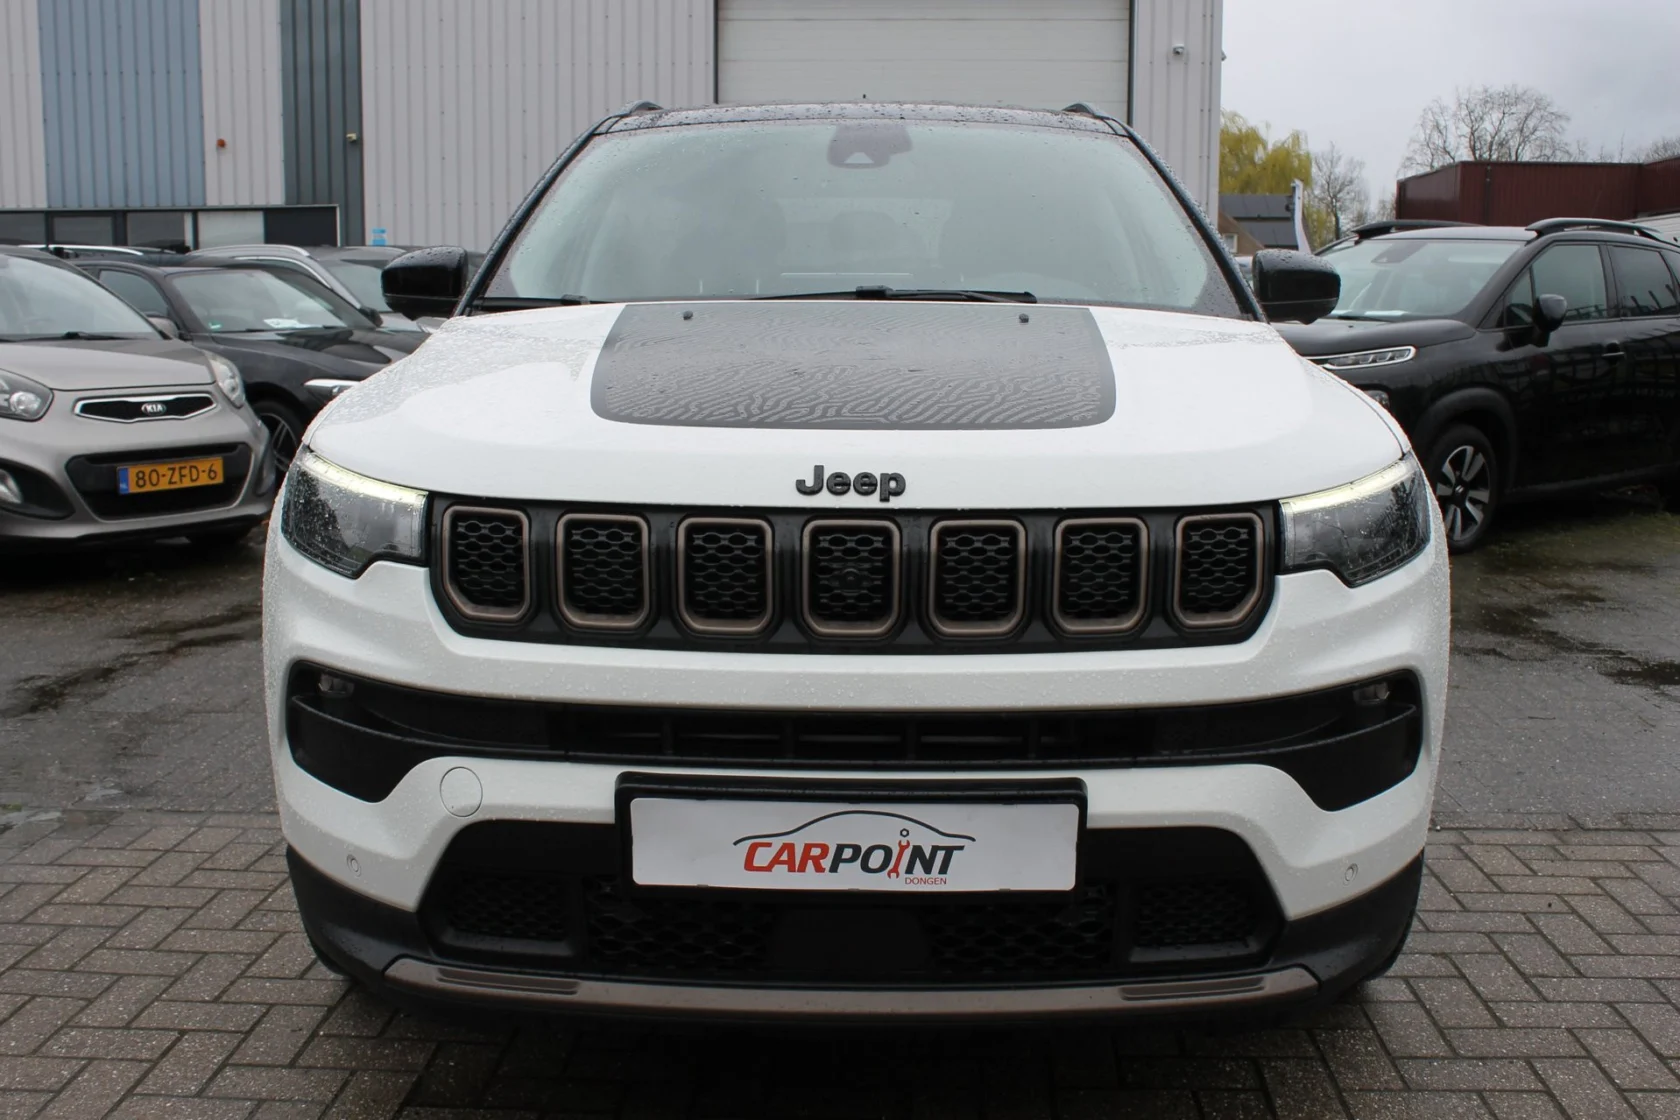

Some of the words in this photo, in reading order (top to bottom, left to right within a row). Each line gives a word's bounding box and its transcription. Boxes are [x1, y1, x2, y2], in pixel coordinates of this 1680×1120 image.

[145, 403, 163, 413] KIA
[135, 463, 217, 489] 80-ZFD-6
[795, 464, 907, 502] Jeep
[904, 876, 947, 886] DONGEN
